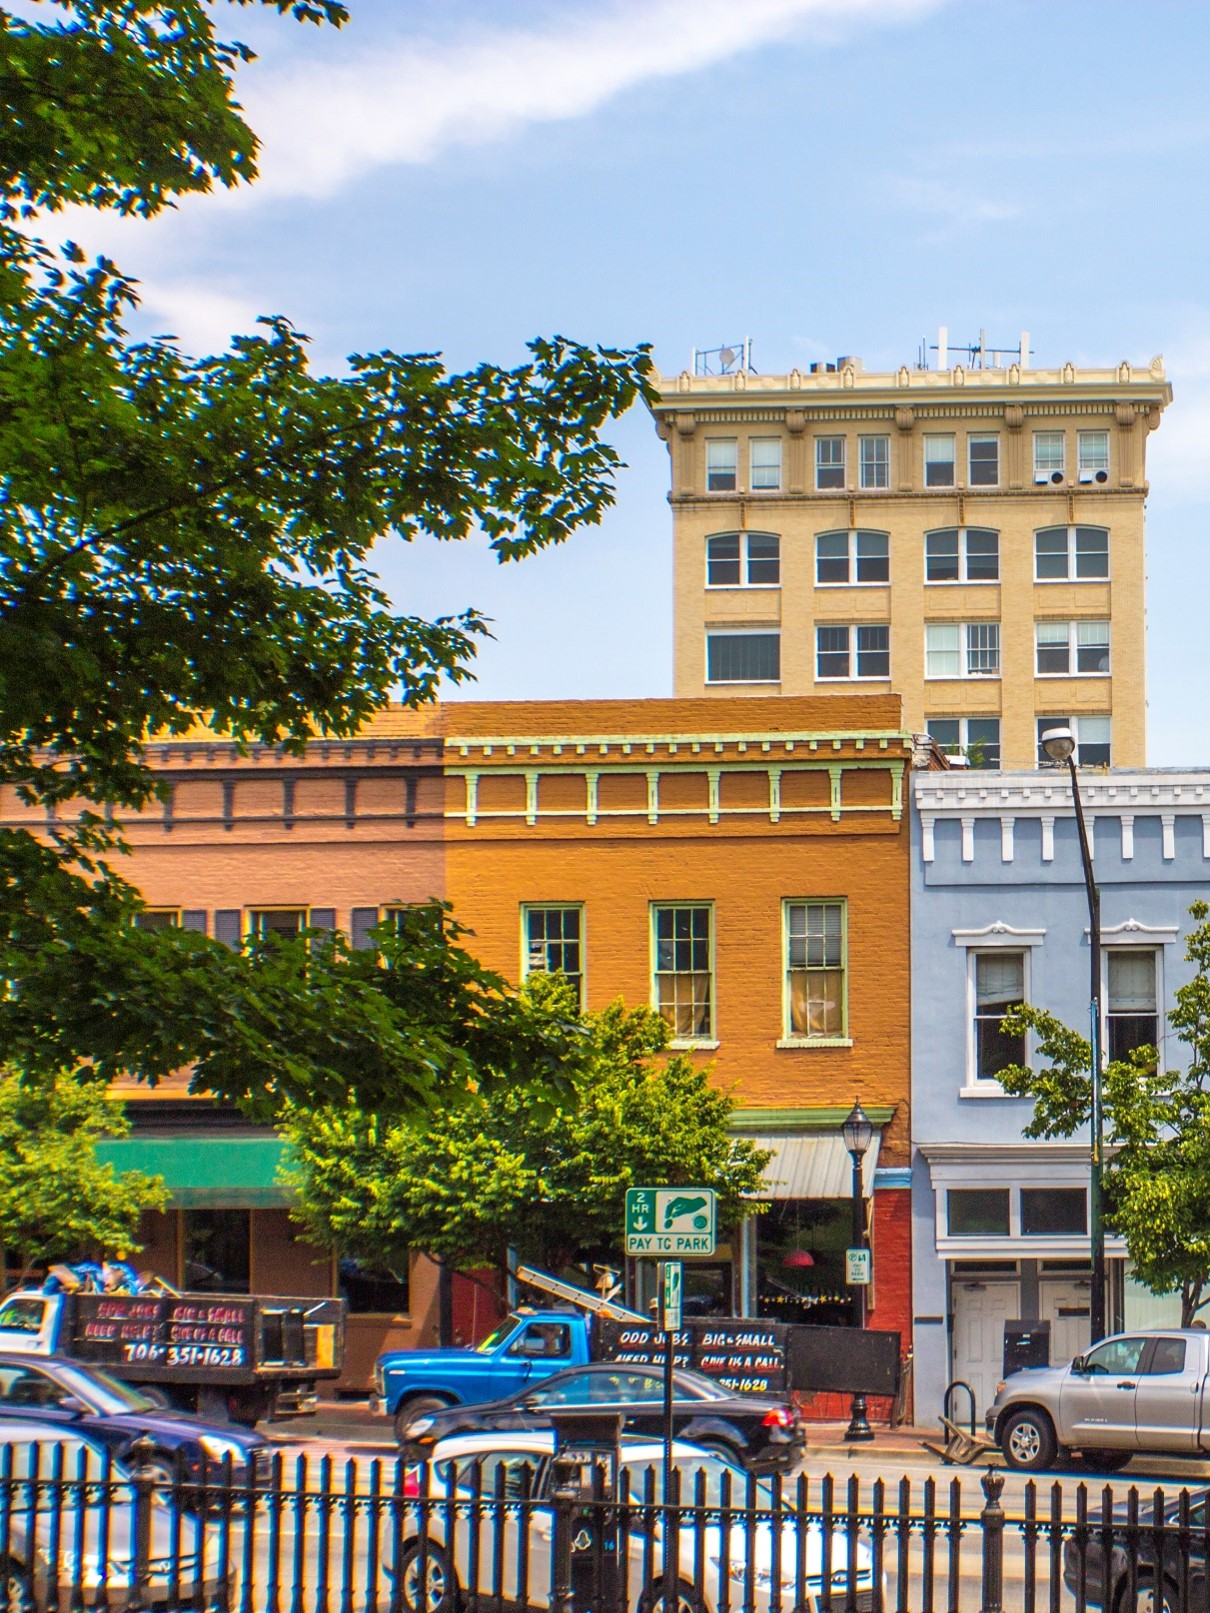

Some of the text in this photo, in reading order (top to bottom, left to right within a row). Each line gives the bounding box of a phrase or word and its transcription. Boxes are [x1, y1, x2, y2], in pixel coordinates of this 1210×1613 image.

[636, 1192, 645, 1203] 2
[631, 1204, 649, 1214] HR
[629, 1238, 652, 1250] PAY
[676, 1238, 709, 1250] PARK
[619, 1332, 649, 1344] ODD
[702, 1333, 725, 1346] BIG
[735, 1333, 775, 1346] SMALL
[700, 1354, 726, 1367] GIVE
[727, 1355, 743, 1367] US
[743, 1355, 753, 1367] A
